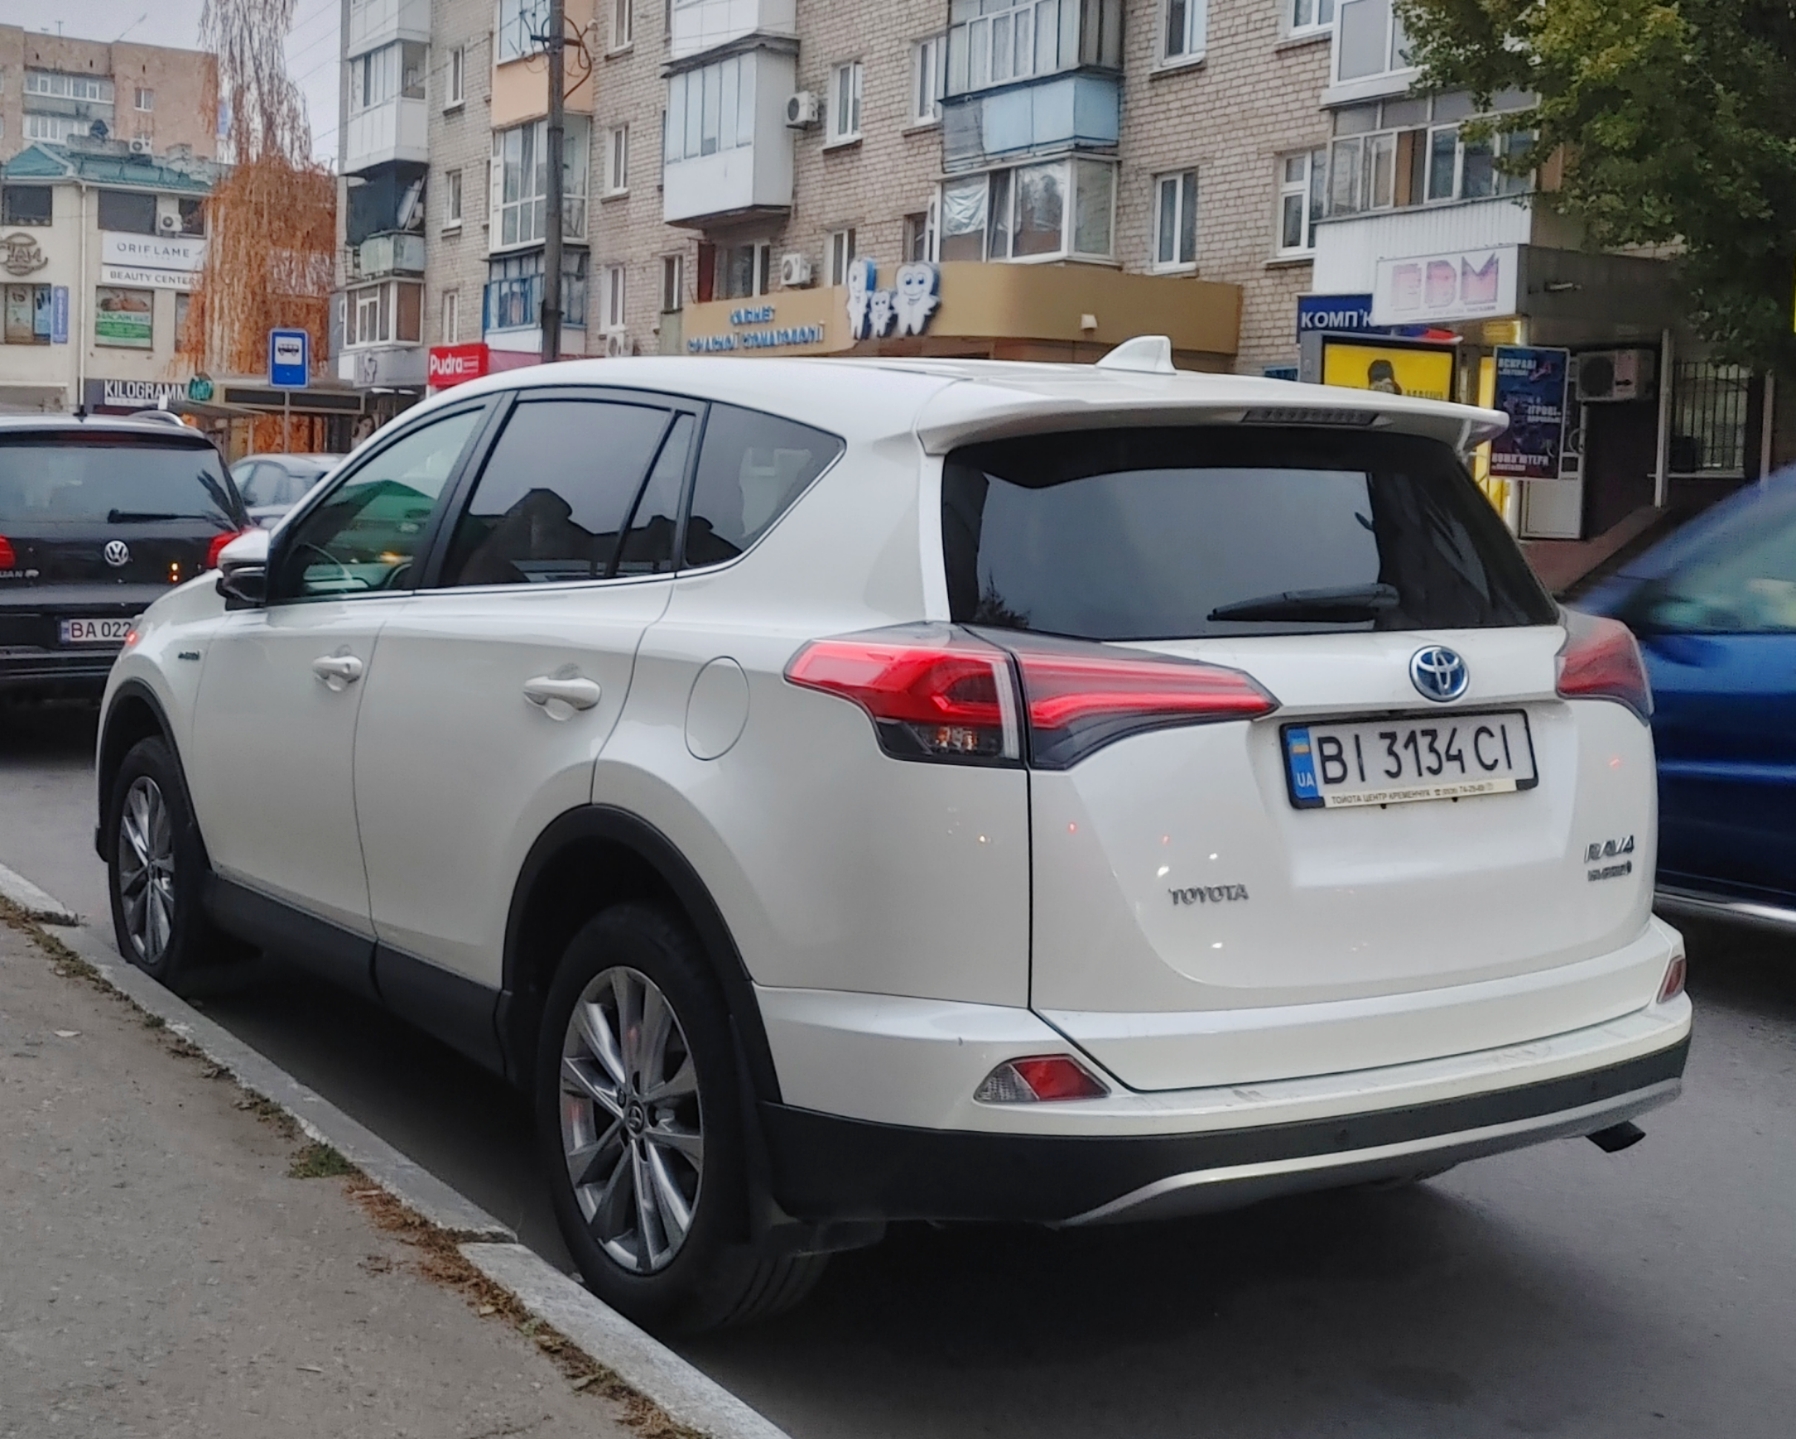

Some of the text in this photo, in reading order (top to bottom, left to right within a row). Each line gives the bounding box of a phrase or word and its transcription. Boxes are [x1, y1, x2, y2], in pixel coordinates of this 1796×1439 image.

[116, 242, 190, 258] ORIFLAME
[110, 270, 152, 282] BEAUTY
[430, 353, 463, 375] Pudra
[71, 621, 97, 638] BA
[1317, 724, 1512, 784] BI 3134 CI
[1296, 772, 1315, 788] UA
[1363, 792, 1388, 803] ЦЕНТР
[1168, 883, 1249, 906] TOYOTA
